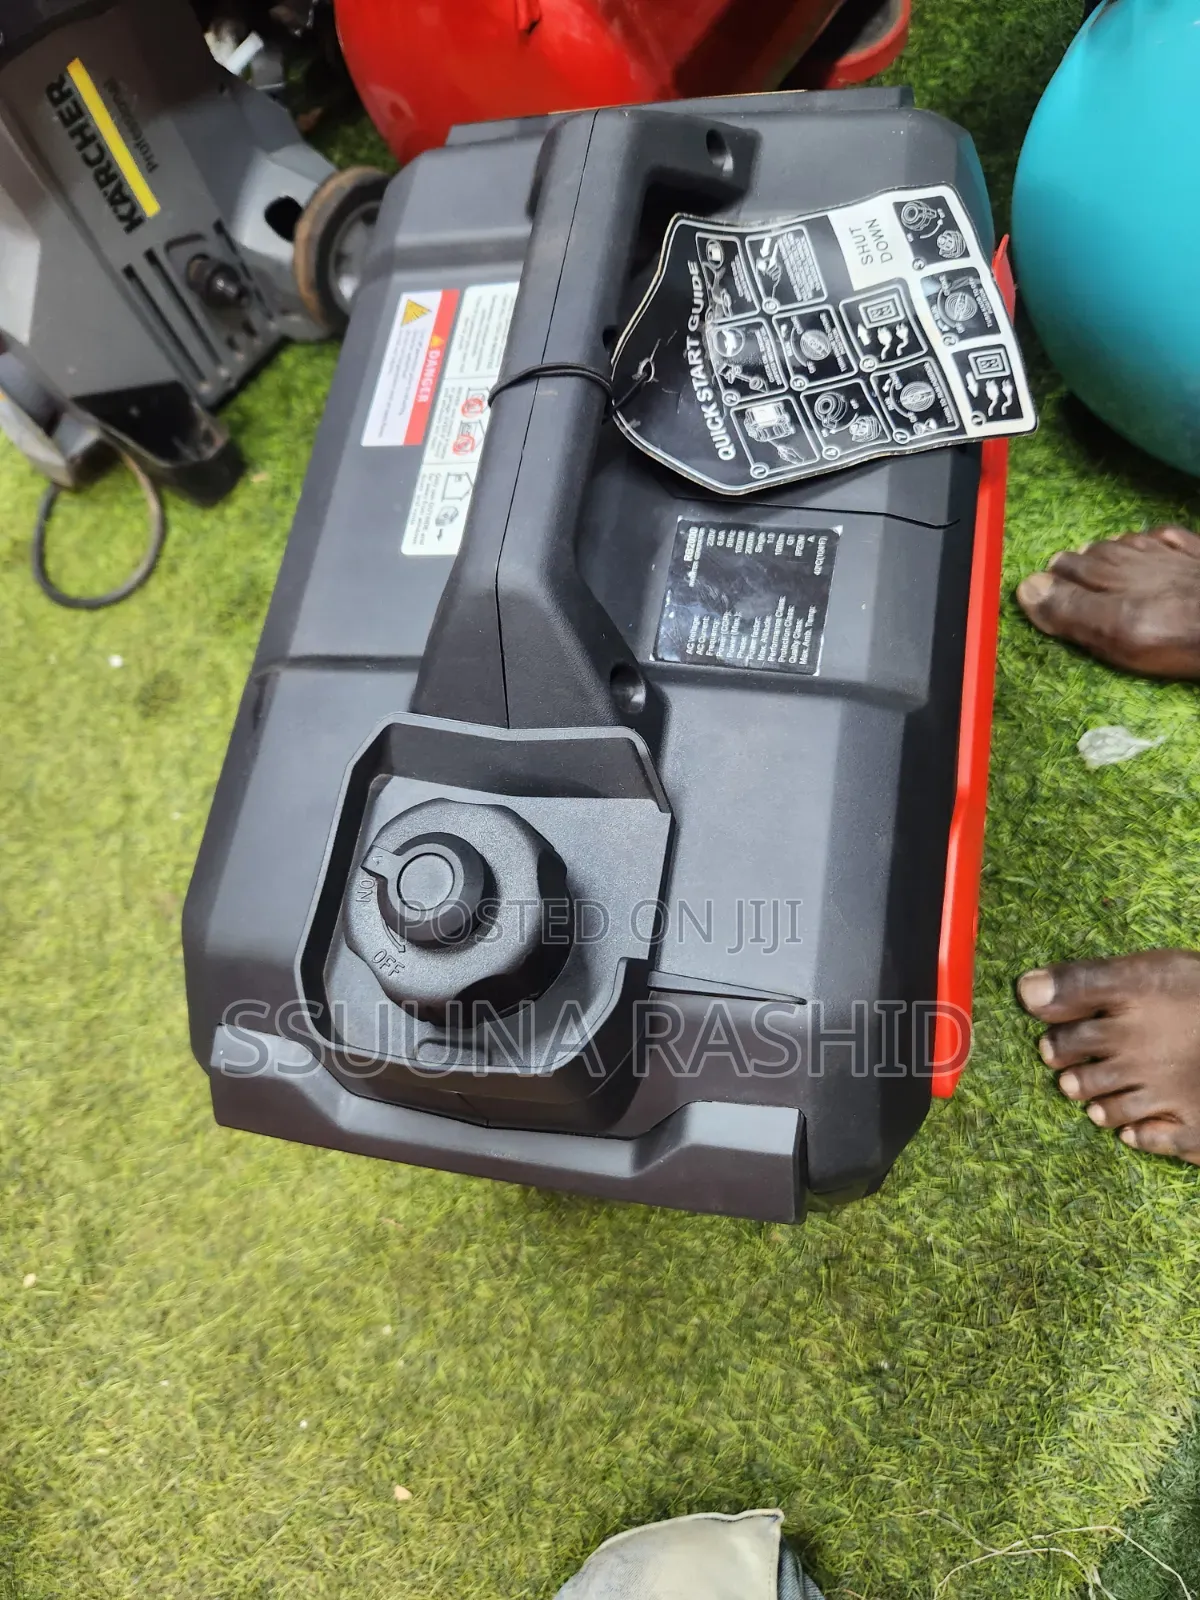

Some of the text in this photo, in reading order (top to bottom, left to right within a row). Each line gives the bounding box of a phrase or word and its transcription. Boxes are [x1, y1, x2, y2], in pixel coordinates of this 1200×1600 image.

[849, 226, 874, 265] SHUT
[866, 218, 893, 263] DOWN
[686, 259, 736, 461] QUICK START GUIDE
[416, 349, 439, 403] DANGER
[683, 526, 698, 561] RB2000
[685, 642, 694, 654] AC
[695, 643, 704, 655] AC
[715, 635, 726, 656] Power
[726, 636, 736, 657] Power
[767, 617, 782, 661] Performance
[777, 627, 790, 662] Protection
[801, 627, 812, 646] Amb.
[788, 639, 801, 664] Quality
[799, 647, 808, 664] Max.
[356, 877, 375, 903] ON
[372, 949, 405, 977] OFF
